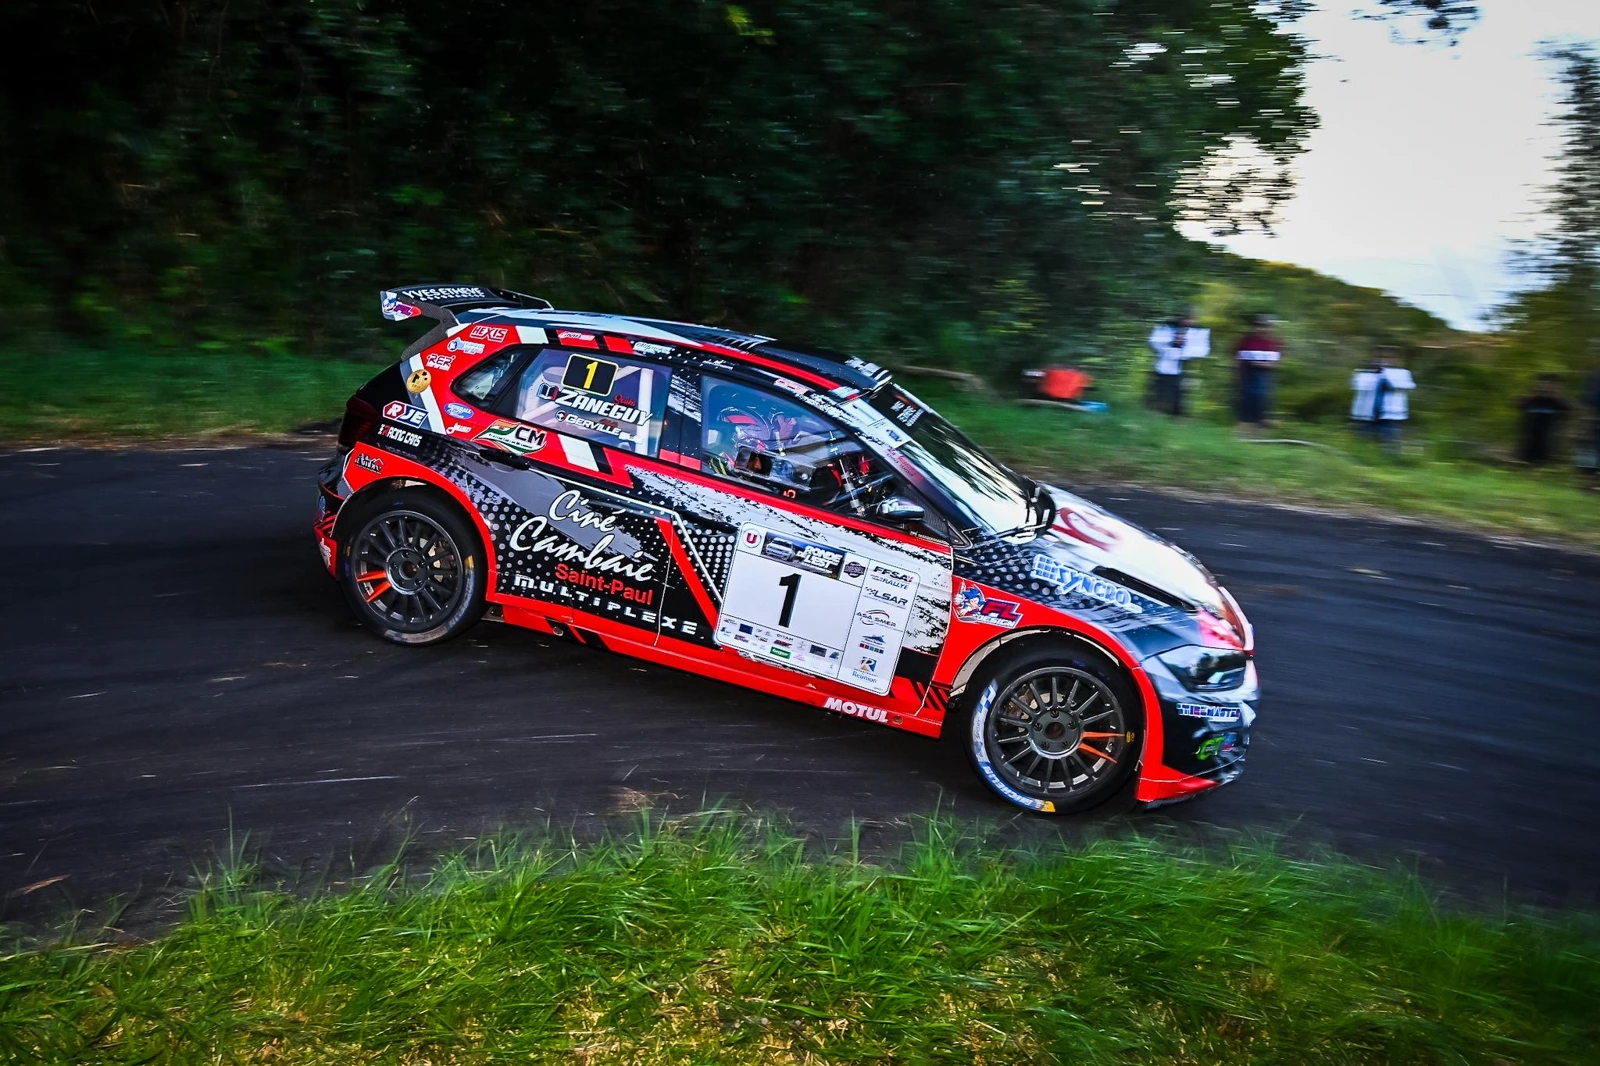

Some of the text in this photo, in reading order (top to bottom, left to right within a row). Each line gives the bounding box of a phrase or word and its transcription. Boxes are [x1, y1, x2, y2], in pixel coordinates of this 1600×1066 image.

[402, 288, 441, 299] YVES
[471, 325, 508, 342] HEXIS
[583, 361, 599, 389] 1
[555, 389, 653, 426] ZANEGUY
[515, 427, 547, 446] CM
[565, 414, 622, 436] GERVILLE
[549, 489, 626, 533] Ciné
[509, 516, 654, 582] Cambaie
[746, 532, 759, 545] U
[555, 563, 653, 605] Saint-Paul
[873, 566, 909, 582] FFSA
[1056, 568, 1131, 605] SYNCRO
[513, 574, 698, 636] MULTIPLEXE
[778, 572, 803, 628] 1
[874, 590, 908, 606] LSAR
[976, 614, 1016, 628] DESIGN
[824, 697, 888, 723] MOTUL
